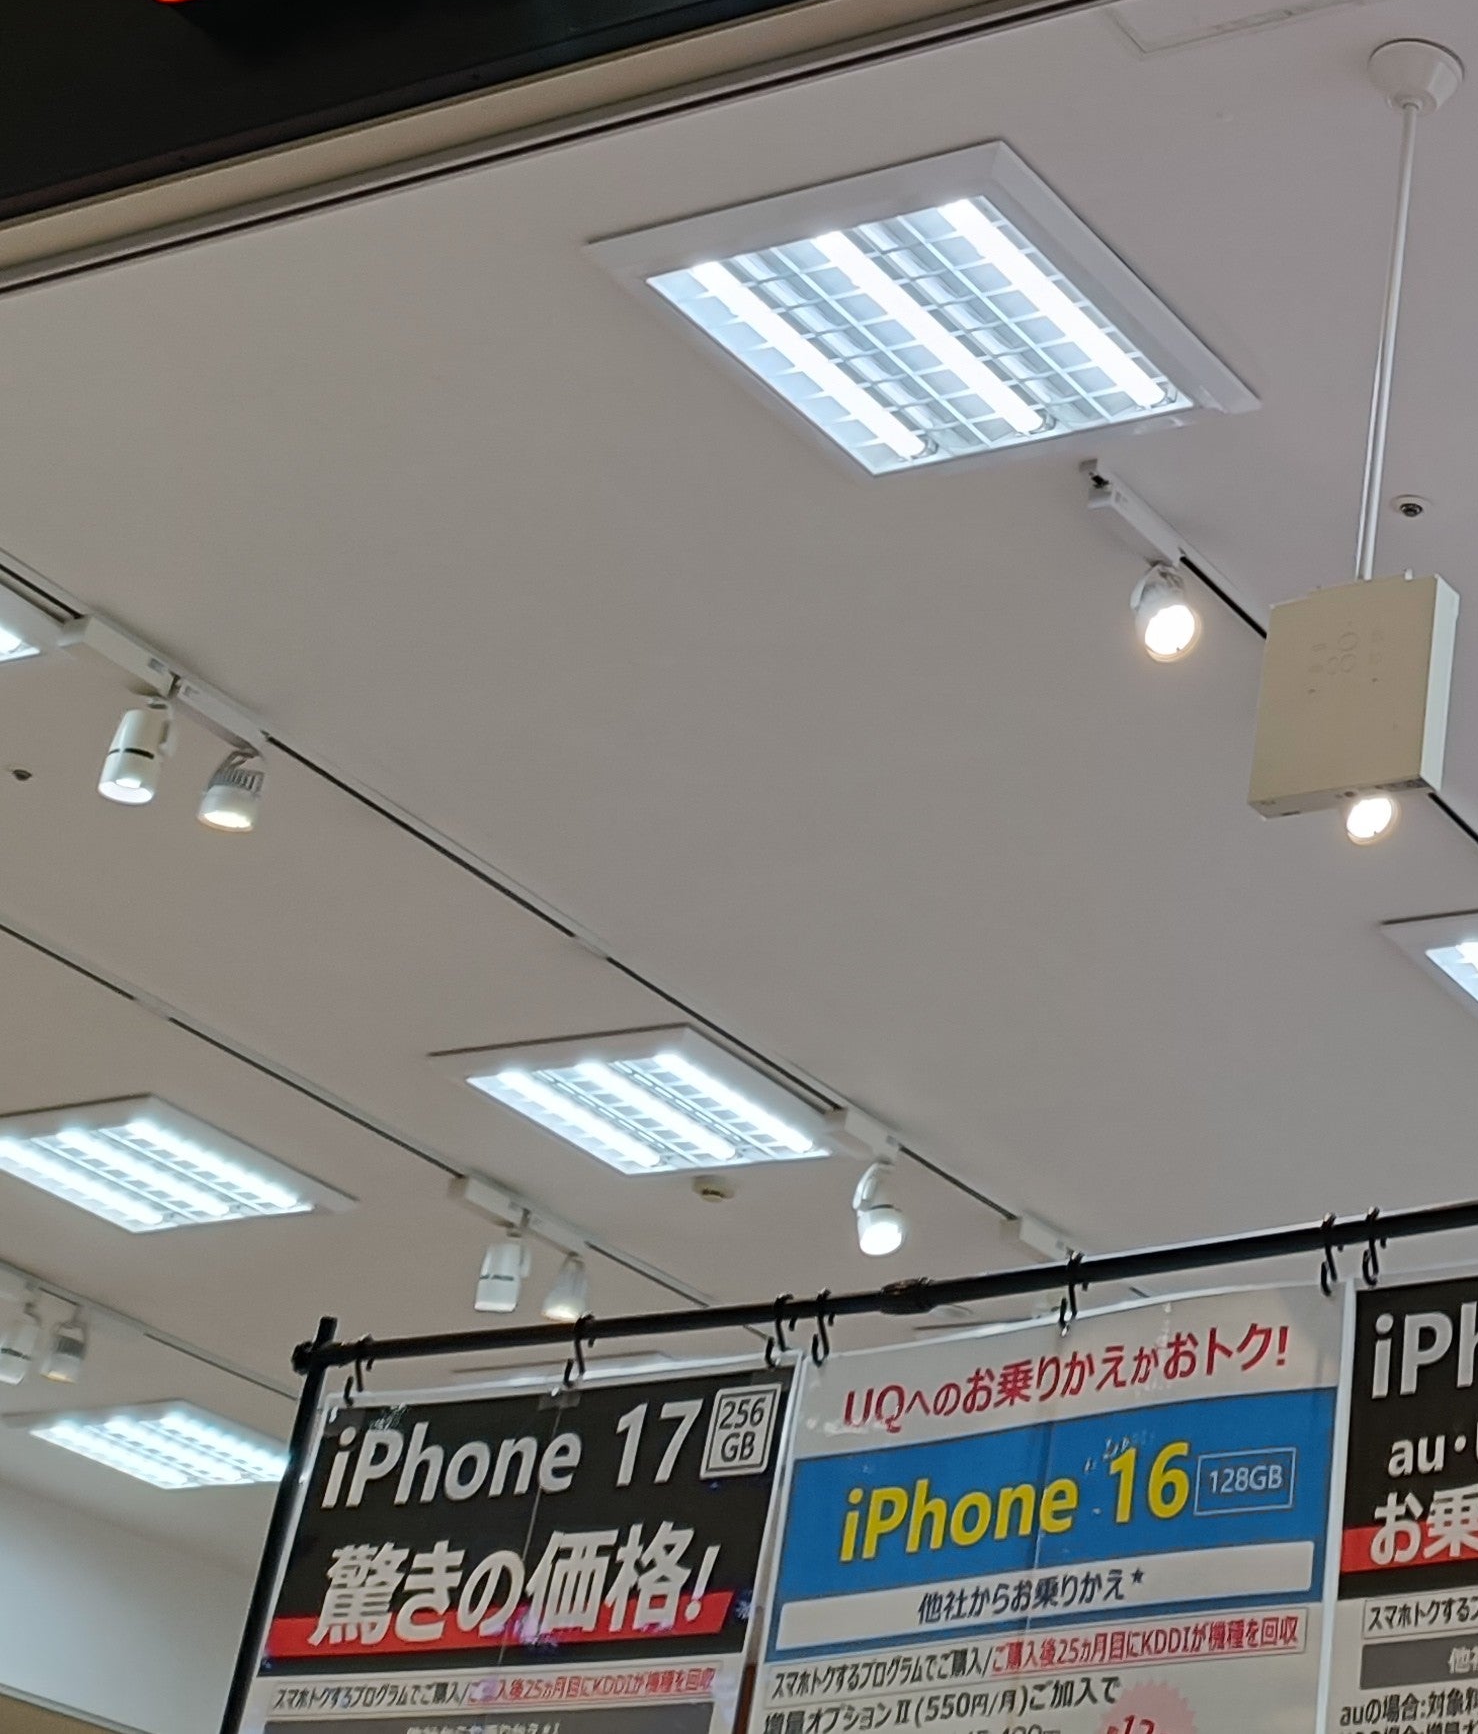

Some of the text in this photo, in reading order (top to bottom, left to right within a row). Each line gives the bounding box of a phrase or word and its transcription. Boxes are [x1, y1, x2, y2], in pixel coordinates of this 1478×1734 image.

[718, 1395, 766, 1430] 256
[843, 1322, 1289, 1433] UQへのお乗りかえがおトク!
[320, 1399, 703, 1509] iPhone 17
[719, 1431, 757, 1464] GB
[838, 1440, 1282, 1562] iPhone 16 128GB
[308, 1520, 720, 1646] 驚きの価格!
